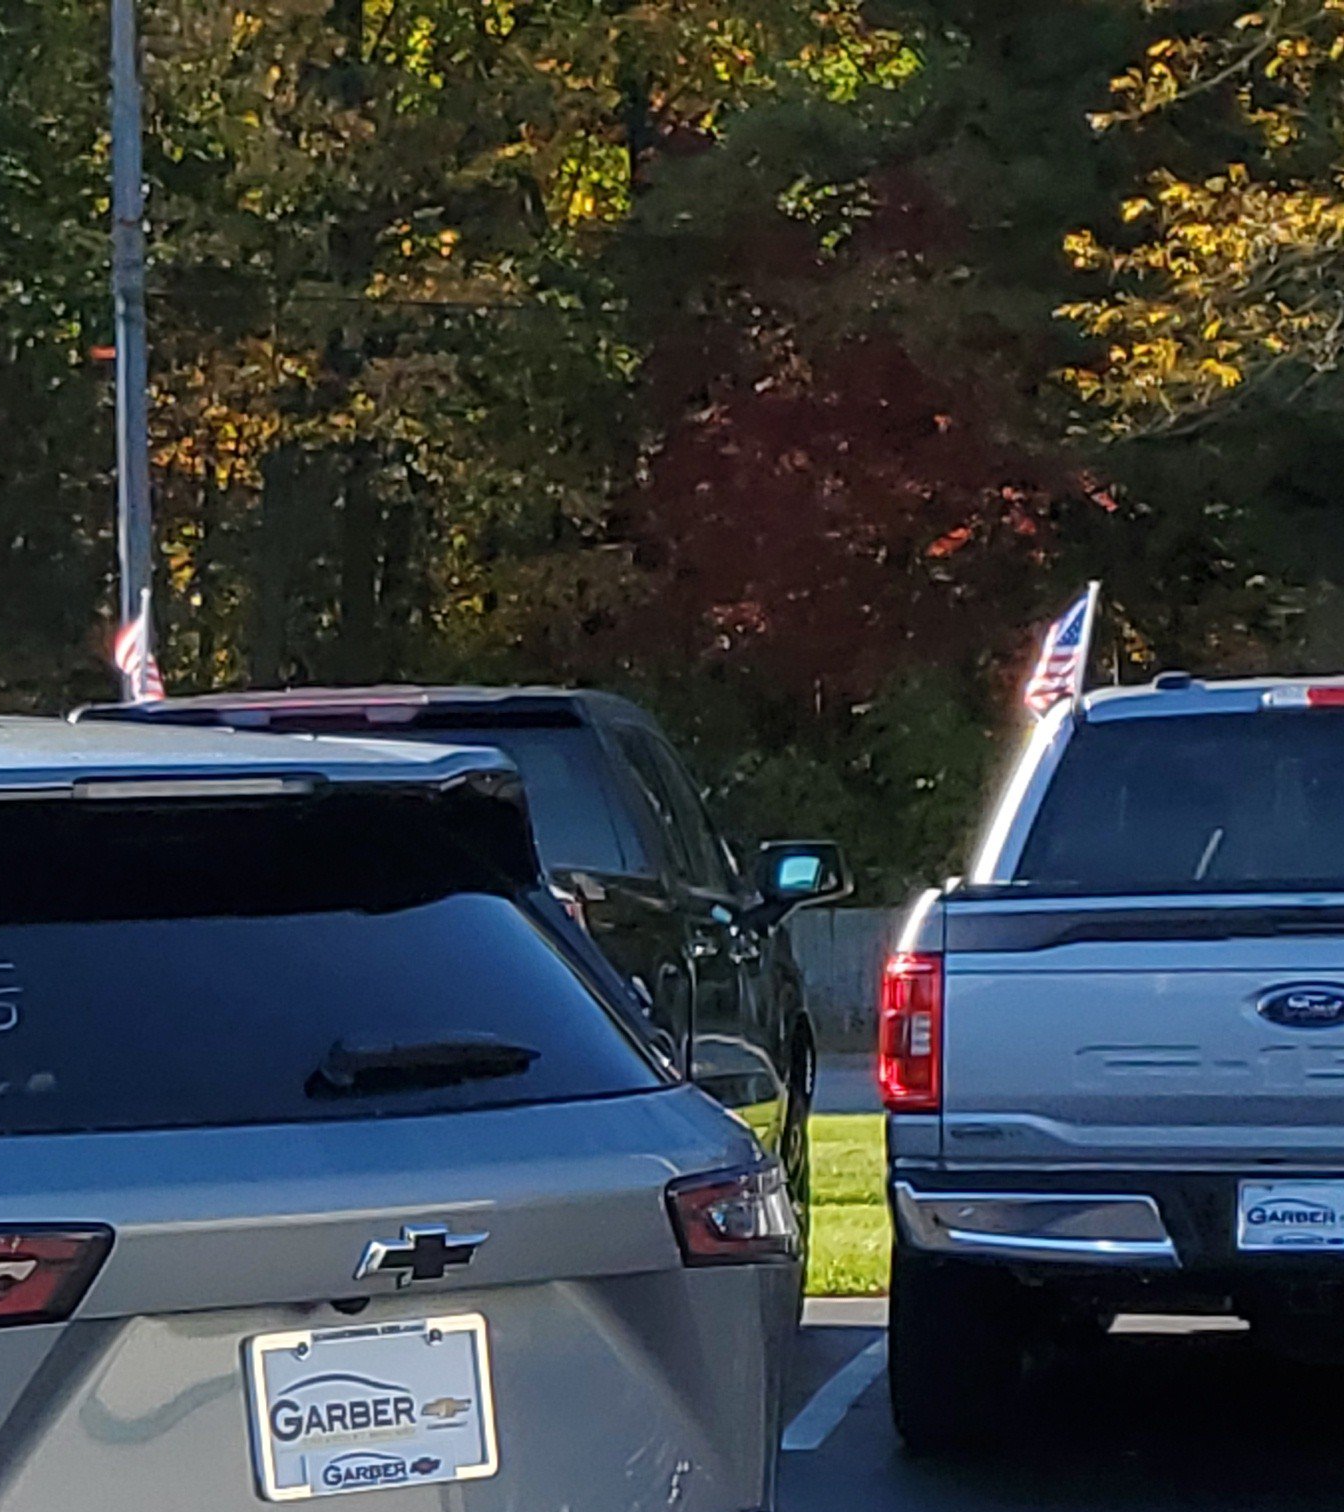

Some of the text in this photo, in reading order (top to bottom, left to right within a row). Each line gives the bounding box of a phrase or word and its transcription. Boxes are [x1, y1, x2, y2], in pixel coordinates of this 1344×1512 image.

[1247, 1207, 1335, 1225] GARBER
[270, 1396, 416, 1442] GARBER
[323, 1461, 408, 1486] GARBER
